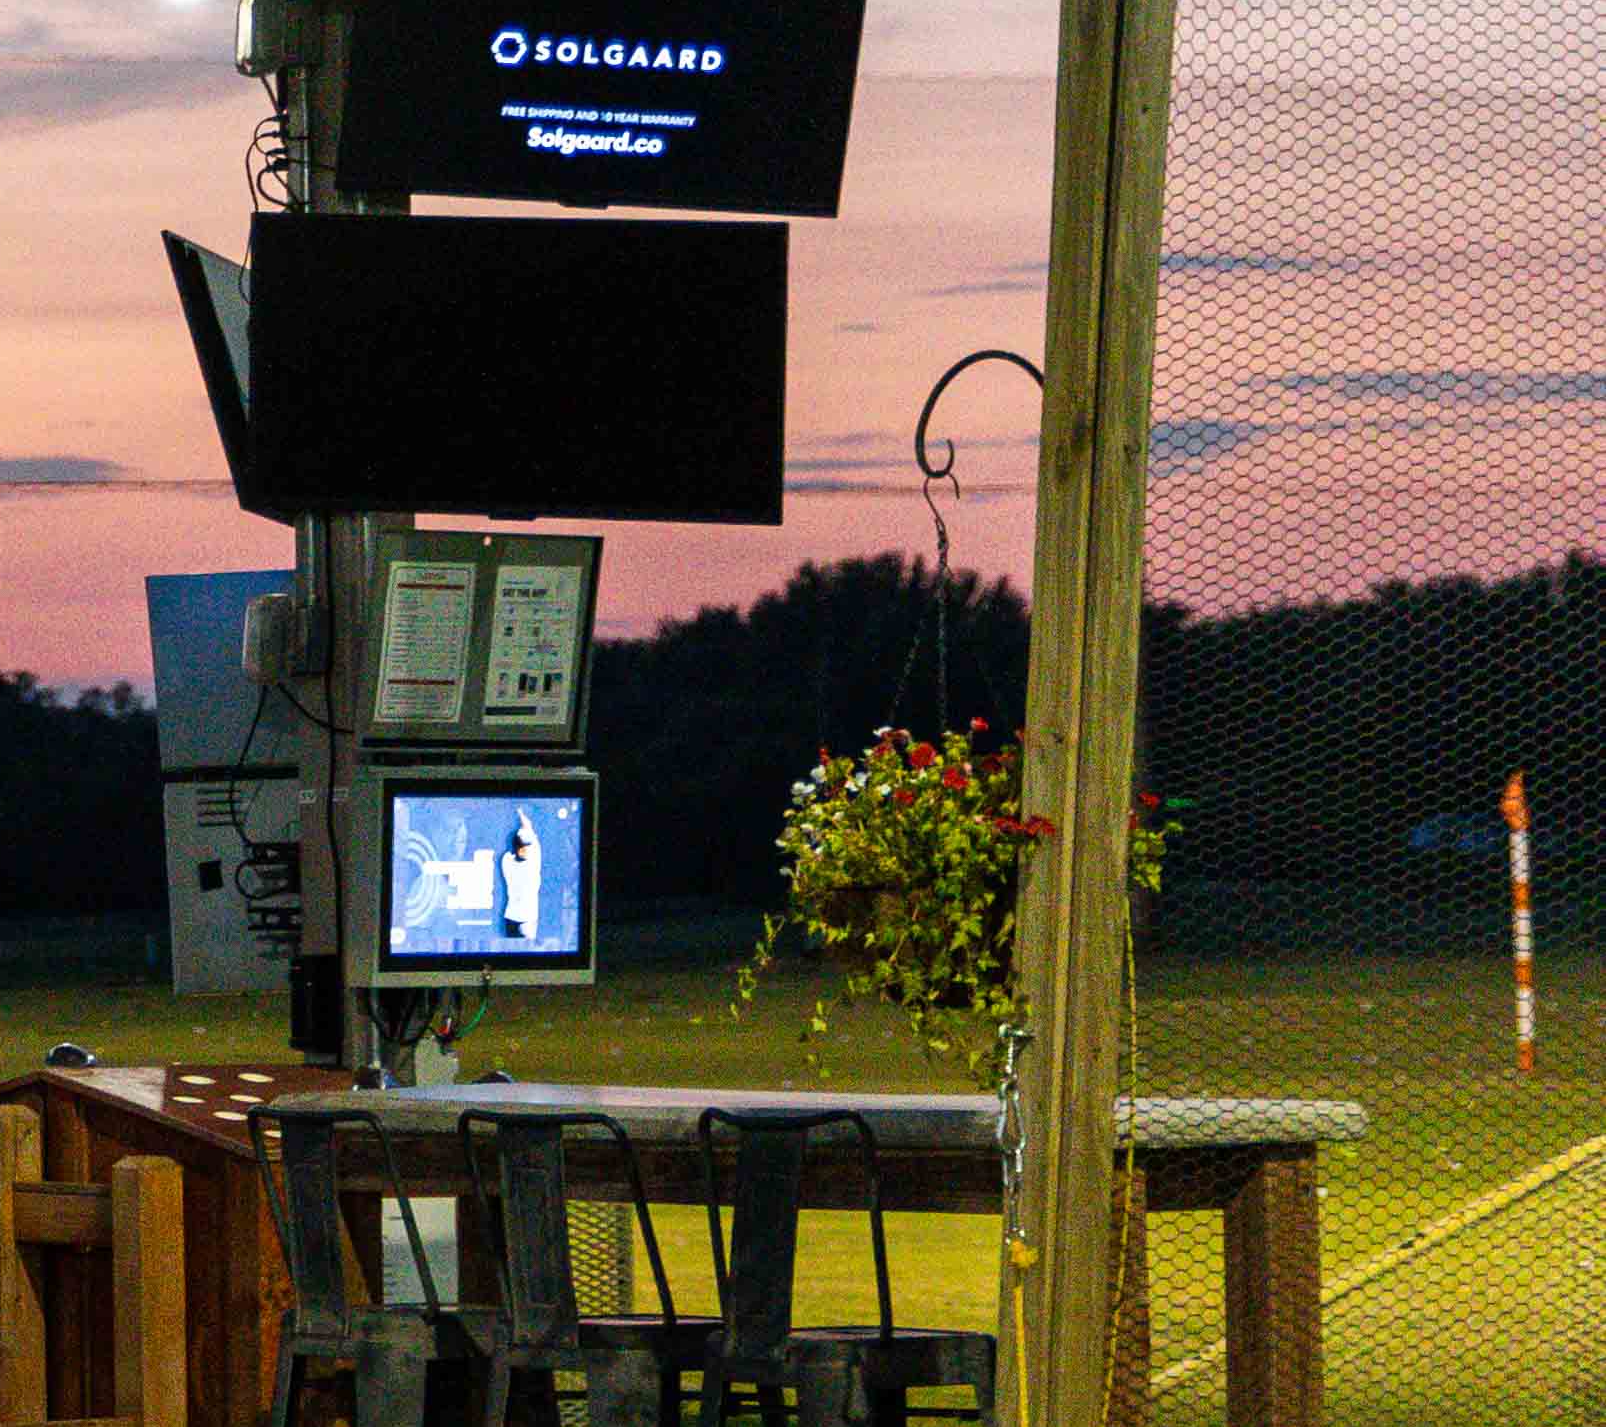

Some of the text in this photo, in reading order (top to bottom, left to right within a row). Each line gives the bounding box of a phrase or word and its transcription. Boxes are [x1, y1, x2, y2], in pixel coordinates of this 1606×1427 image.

[534, 39, 722, 72] SOLGAARD
[501, 105, 526, 118] FREE
[527, 107, 575, 120] SHIPPING
[575, 110, 599, 122] AND
[614, 113, 640, 124] YEAR
[641, 114, 696, 127] WARRANTY
[527, 126, 664, 155] Solgaard.co
